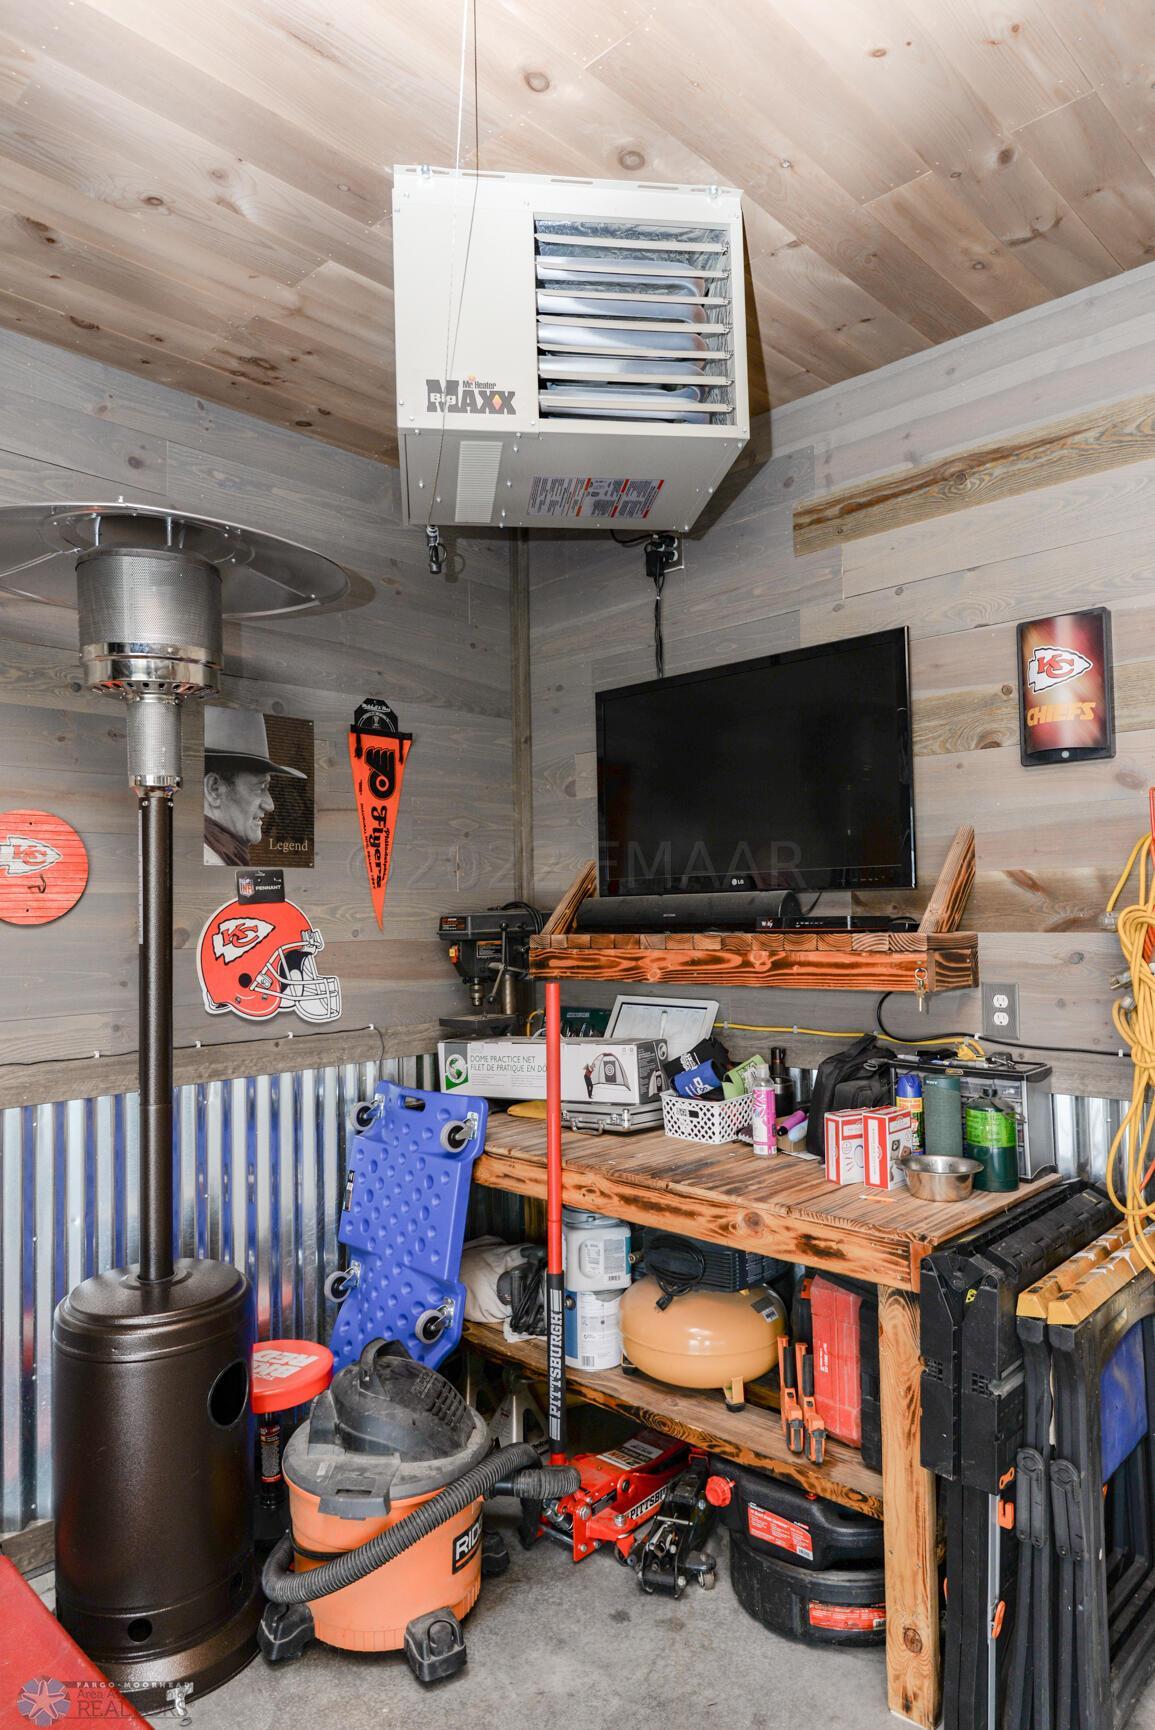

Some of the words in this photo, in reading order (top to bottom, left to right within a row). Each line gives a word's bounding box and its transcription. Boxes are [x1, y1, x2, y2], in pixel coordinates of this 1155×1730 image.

[475, 381, 497, 390] Heater
[426, 379, 516, 415] MAXX
[430, 392, 457, 405] Big
[1027, 702, 1096, 727] CHIEFS
[269, 838, 309, 853] Legend
[370, 805, 388, 888] Flyers
[470, 1055, 489, 1063] DOME
[490, 1055, 521, 1063] PRACTICE
[522, 1055, 536, 1064] NET
[470, 1063, 485, 1071] FILET
[486, 1064, 495, 1072] DE
[496, 1064, 525, 1074] PRATIQUE
[549, 1310, 563, 1420] PITTSBURGH
